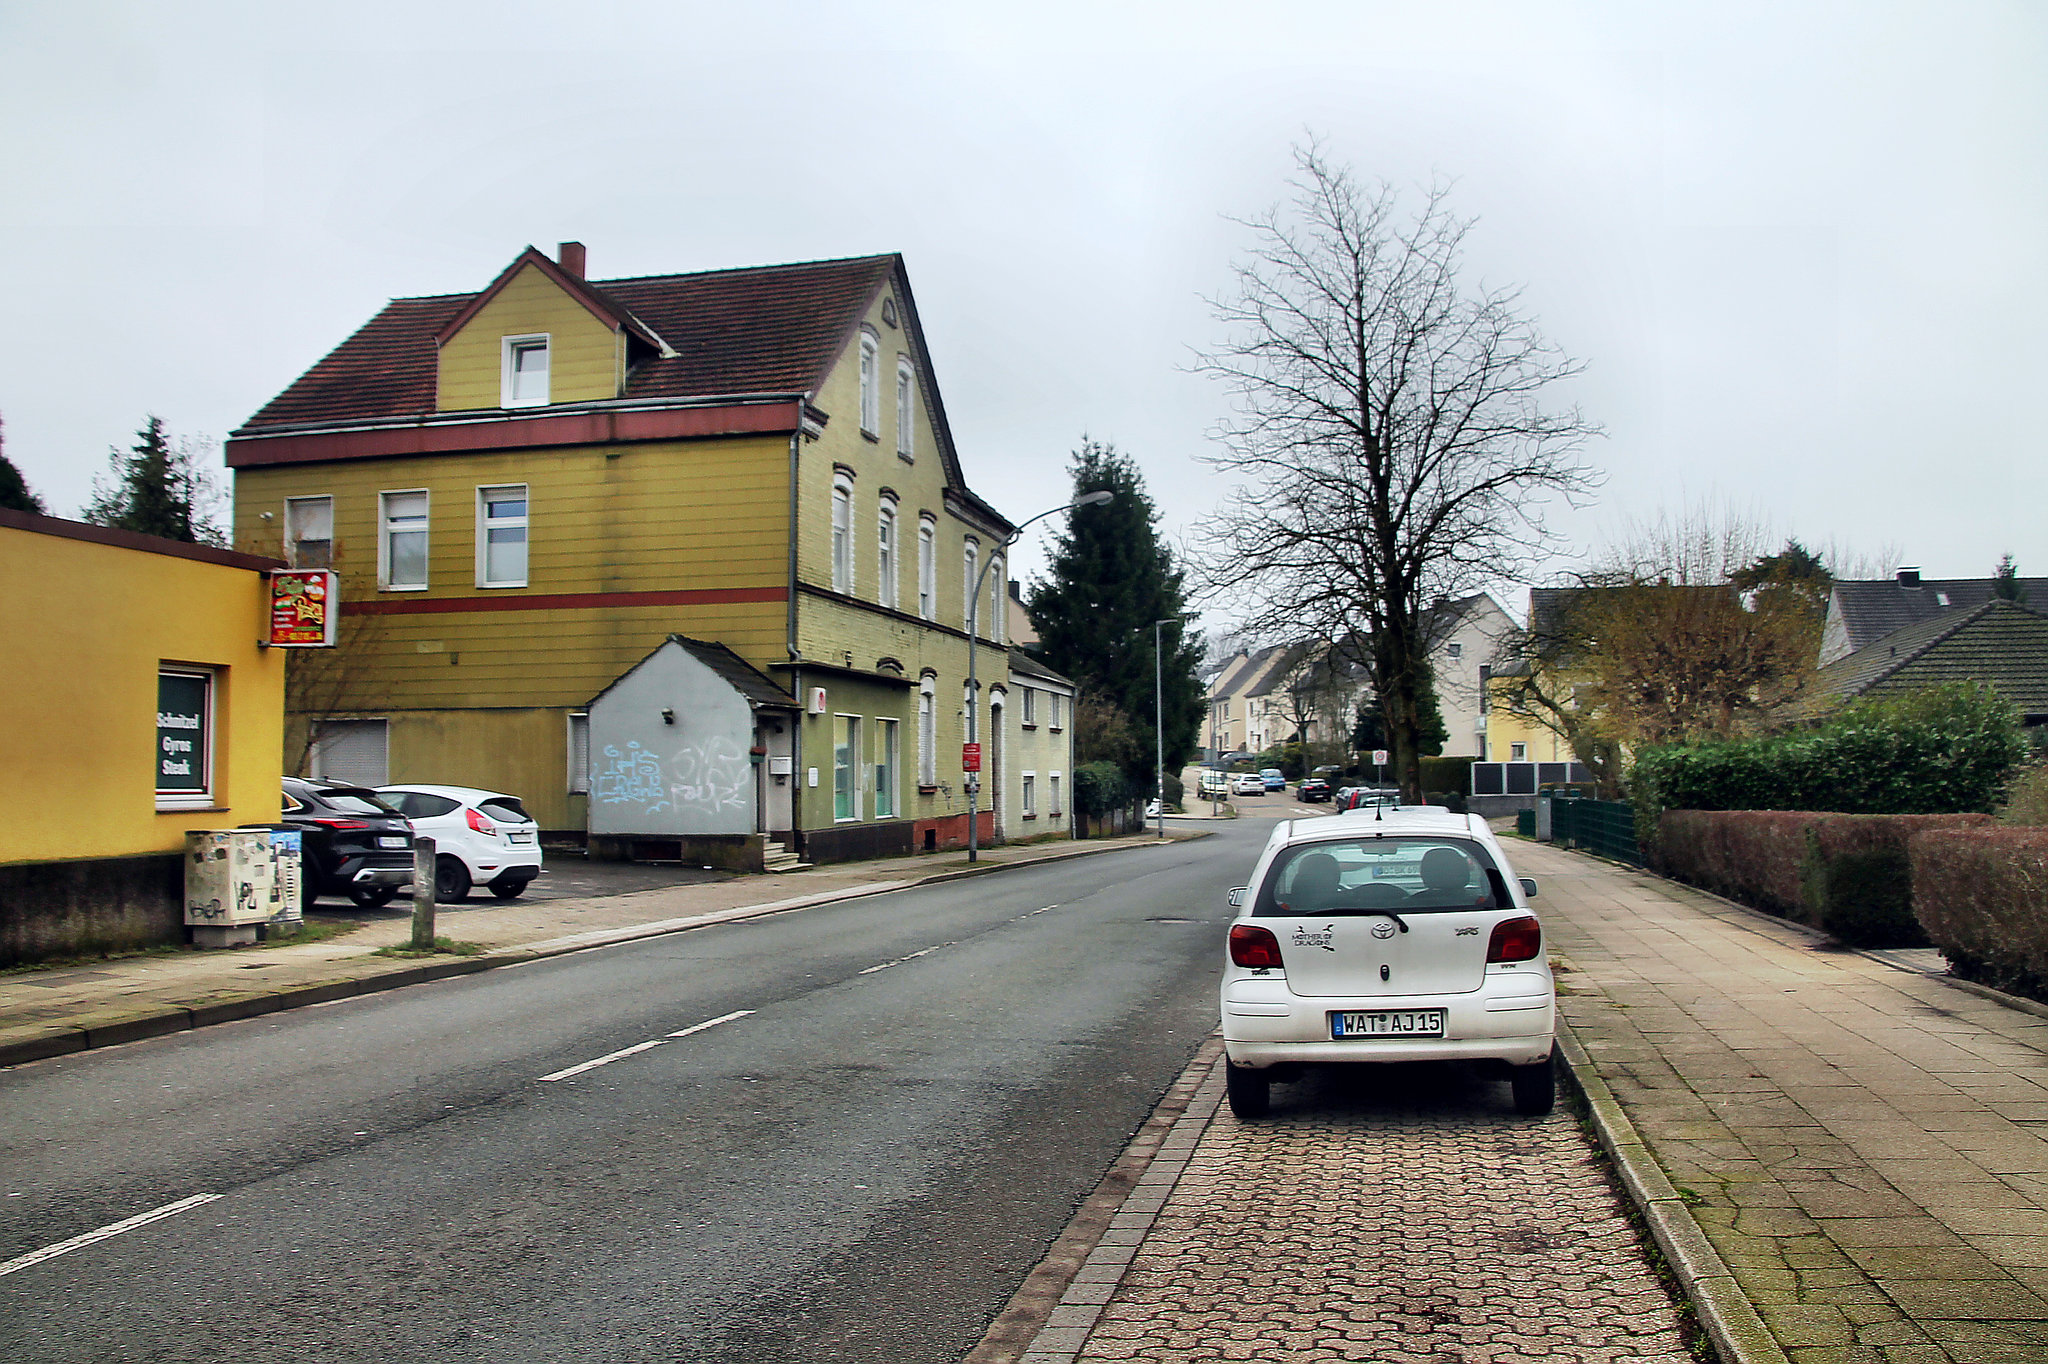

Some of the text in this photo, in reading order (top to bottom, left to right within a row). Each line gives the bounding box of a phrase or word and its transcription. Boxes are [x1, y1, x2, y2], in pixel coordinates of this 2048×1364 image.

[157, 712, 200, 730] Schnitzel
[162, 736, 192, 756] Gyros
[162, 759, 191, 775] Steak
[1343, 1014, 1378, 1033] WAT
